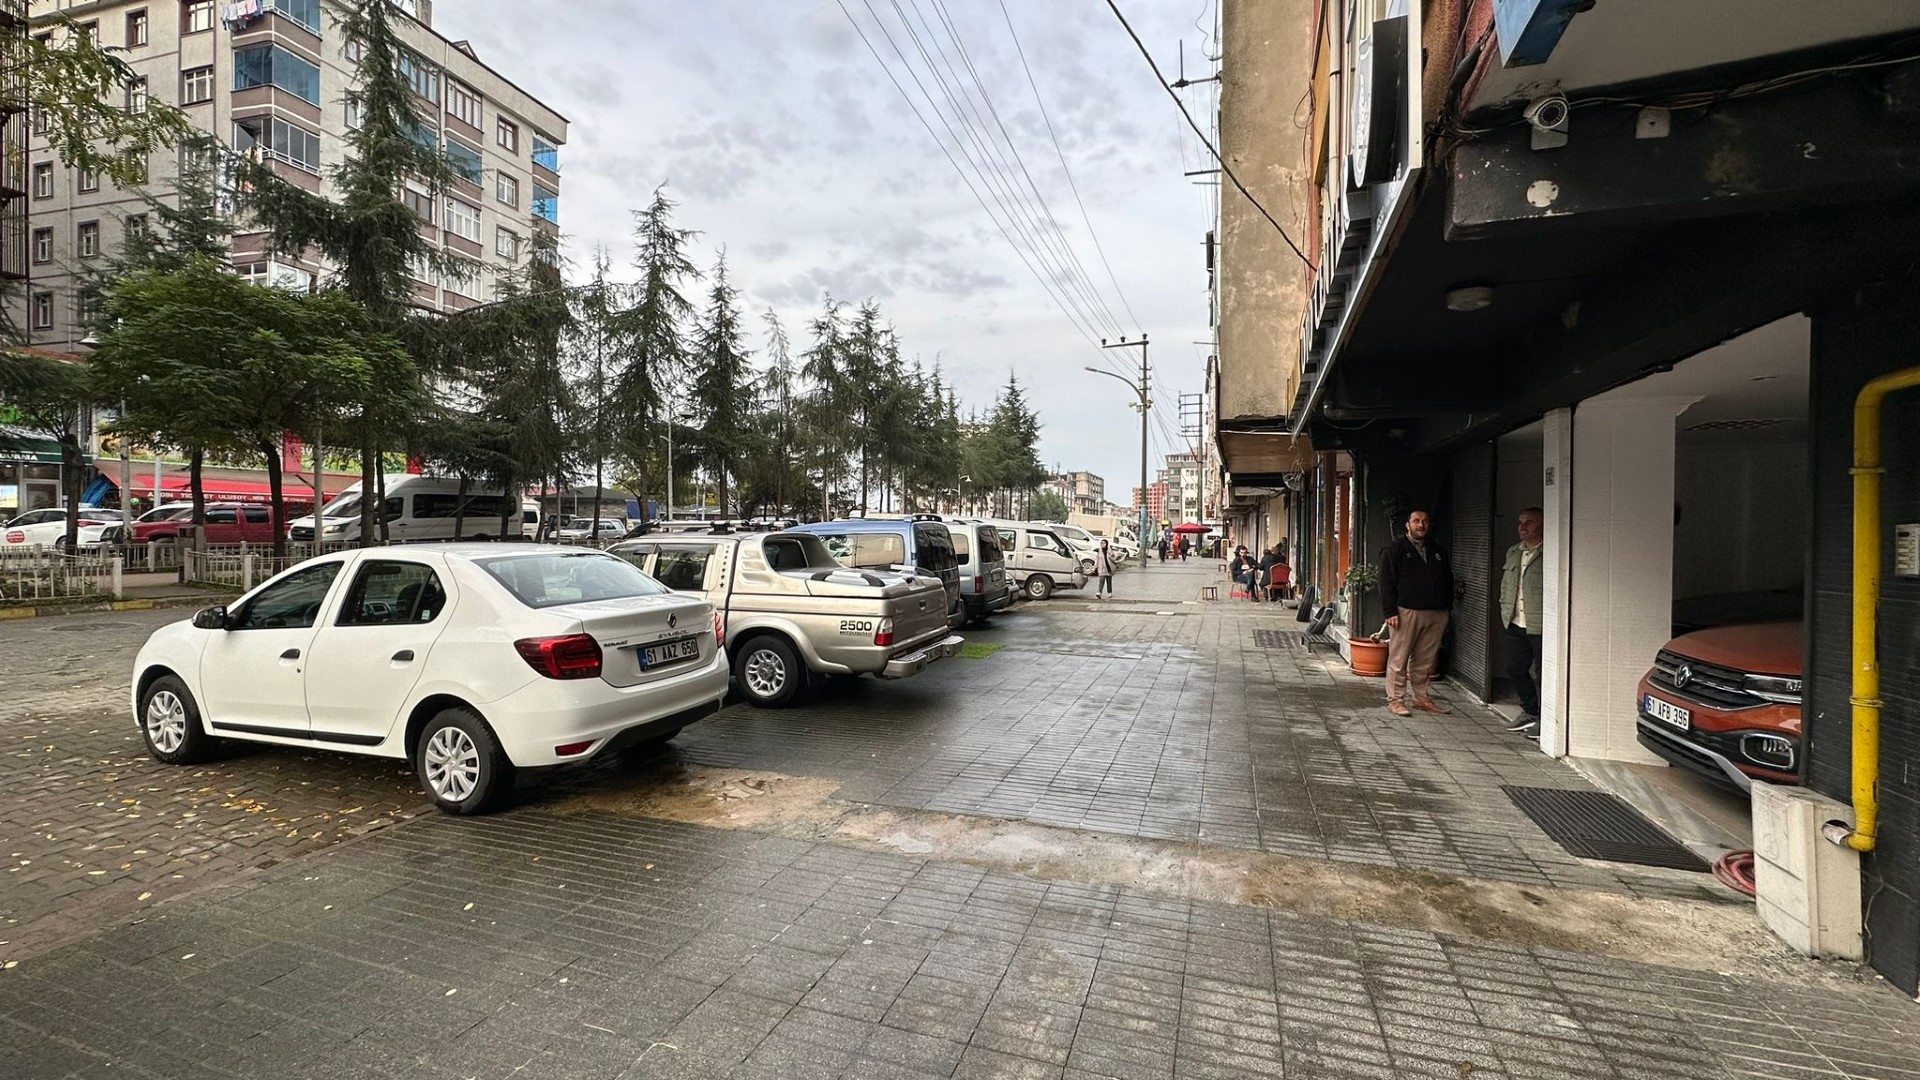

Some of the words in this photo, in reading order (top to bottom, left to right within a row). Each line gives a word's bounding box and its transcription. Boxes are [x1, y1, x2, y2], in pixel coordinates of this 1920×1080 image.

[840, 620, 873, 631] 2500
[646, 648, 657, 663] 61
[662, 645, 678, 660] AAZ
[681, 640, 697, 656] 650
[1647, 698, 1655, 714] 61
[1658, 702, 1671, 720] AFB
[1673, 708, 1688, 727] 396
